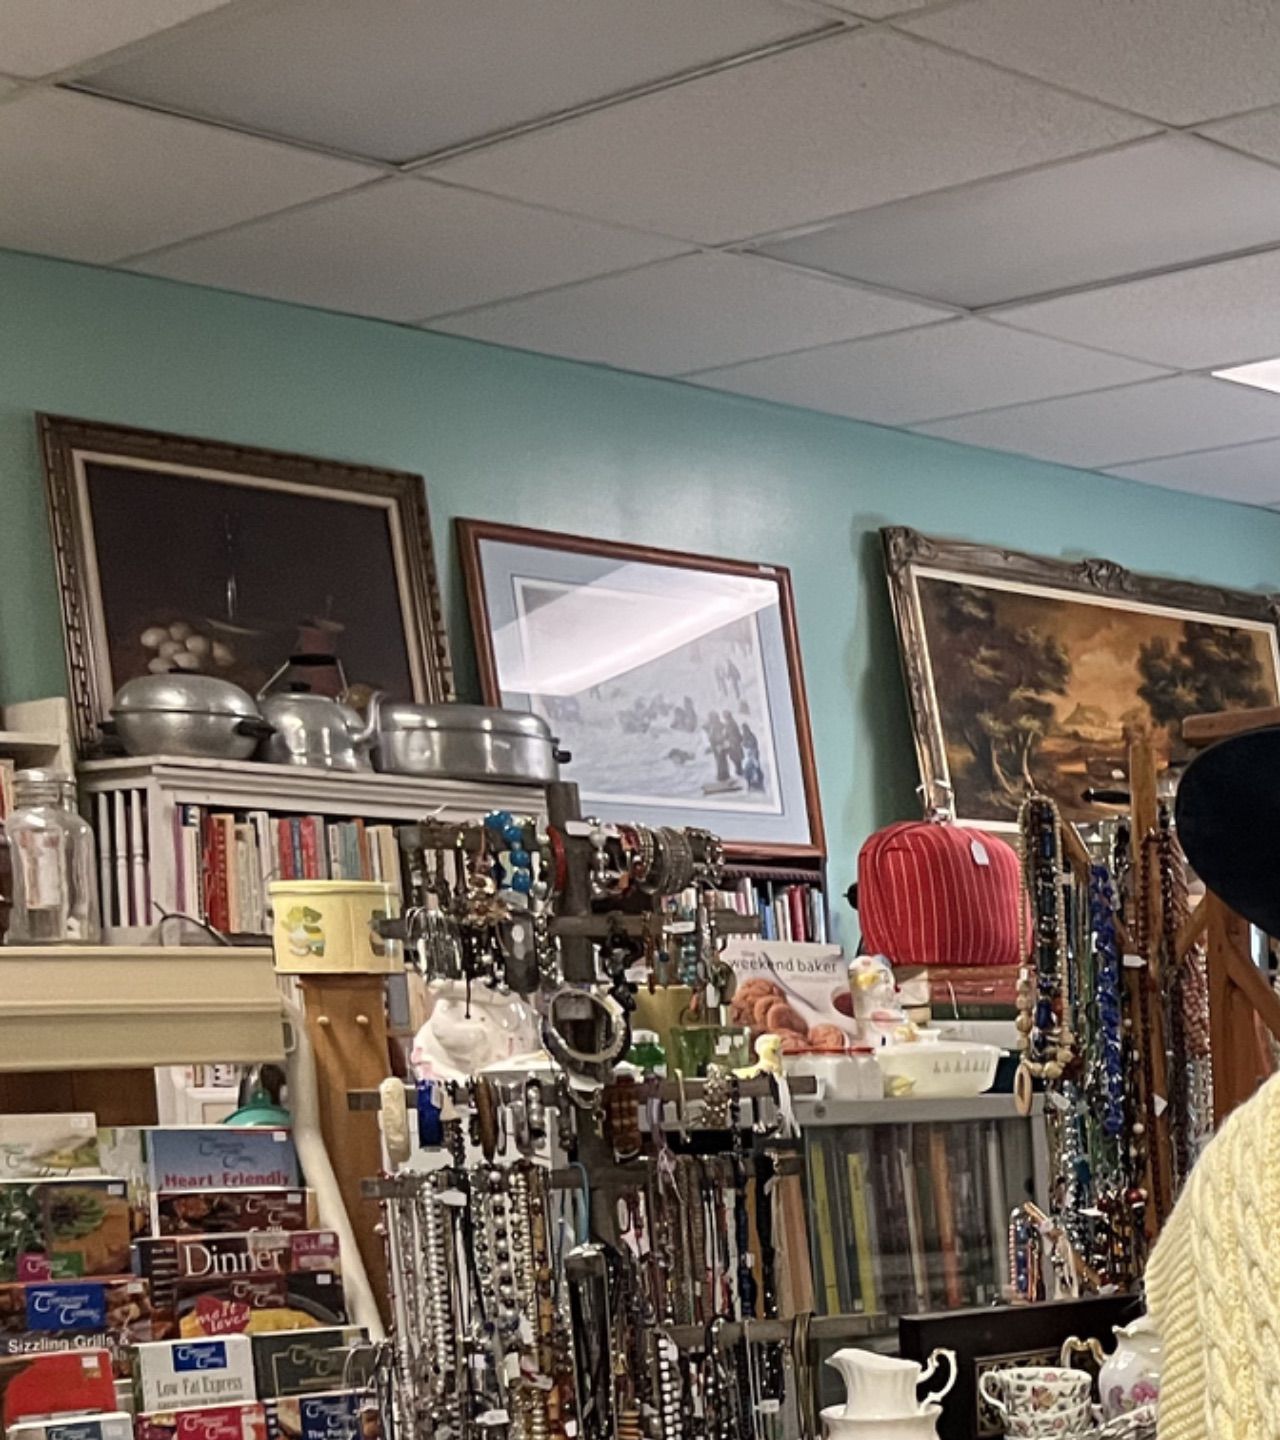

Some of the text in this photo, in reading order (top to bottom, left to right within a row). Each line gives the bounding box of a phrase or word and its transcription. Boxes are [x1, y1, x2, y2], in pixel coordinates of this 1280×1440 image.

[797, 958, 837, 973] baker
[164, 1170, 290, 1188] Heart Friendly
[184, 1243, 284, 1278] Dinner
[8, 1337, 70, 1354] Sizzling
[73, 1333, 115, 1349] Grills
[156, 1375, 243, 1398] Low Fat Express
